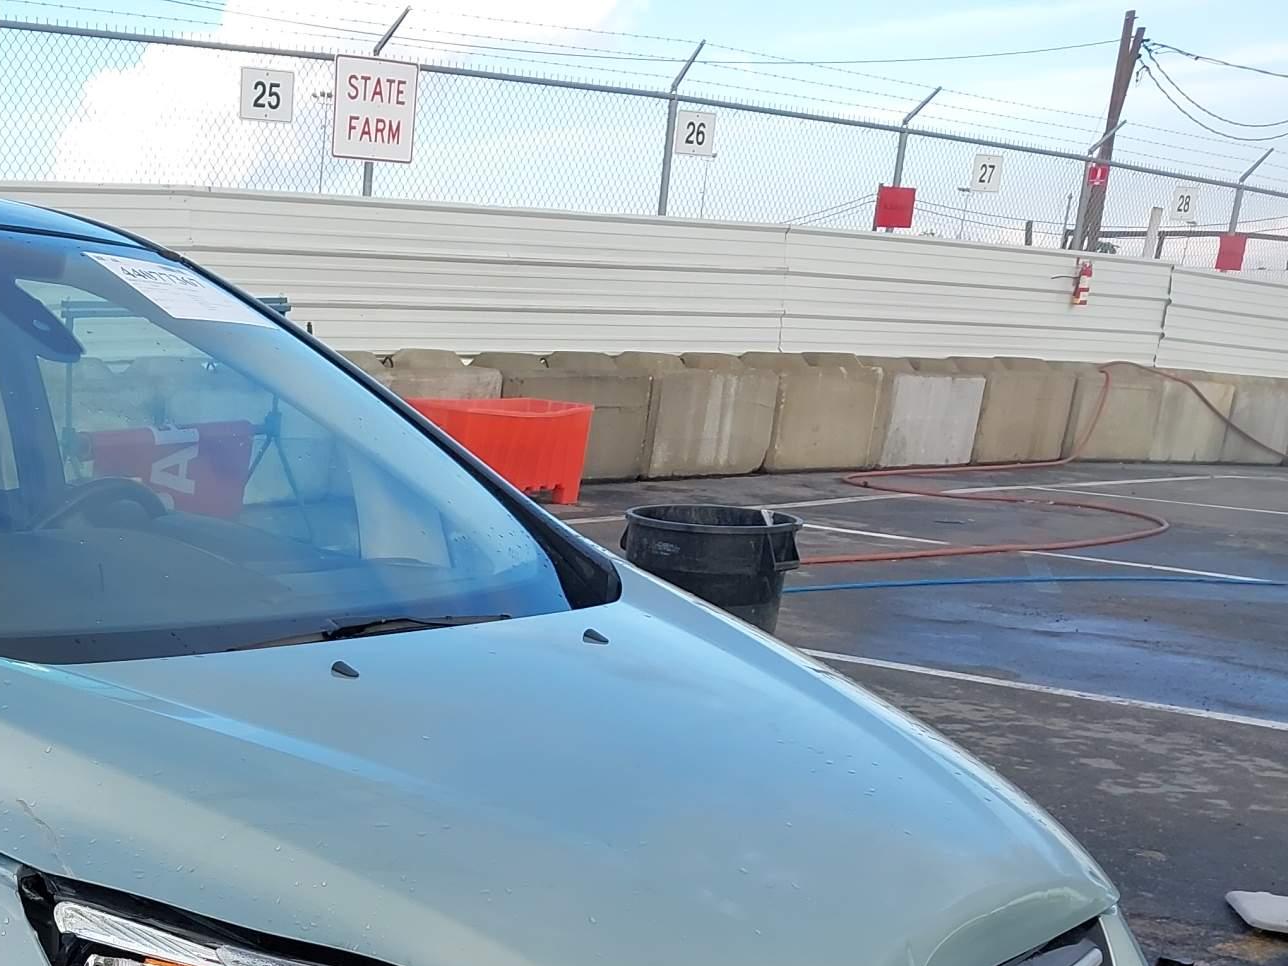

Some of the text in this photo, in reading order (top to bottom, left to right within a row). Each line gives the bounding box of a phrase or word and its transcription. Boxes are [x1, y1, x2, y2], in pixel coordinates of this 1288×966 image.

[253, 80, 281, 110] 25
[347, 74, 407, 106] STATE
[347, 115, 401, 145] FARM
[685, 121, 706, 146] 26
[978, 163, 996, 184] 27
[1177, 195, 1191, 213] 28
